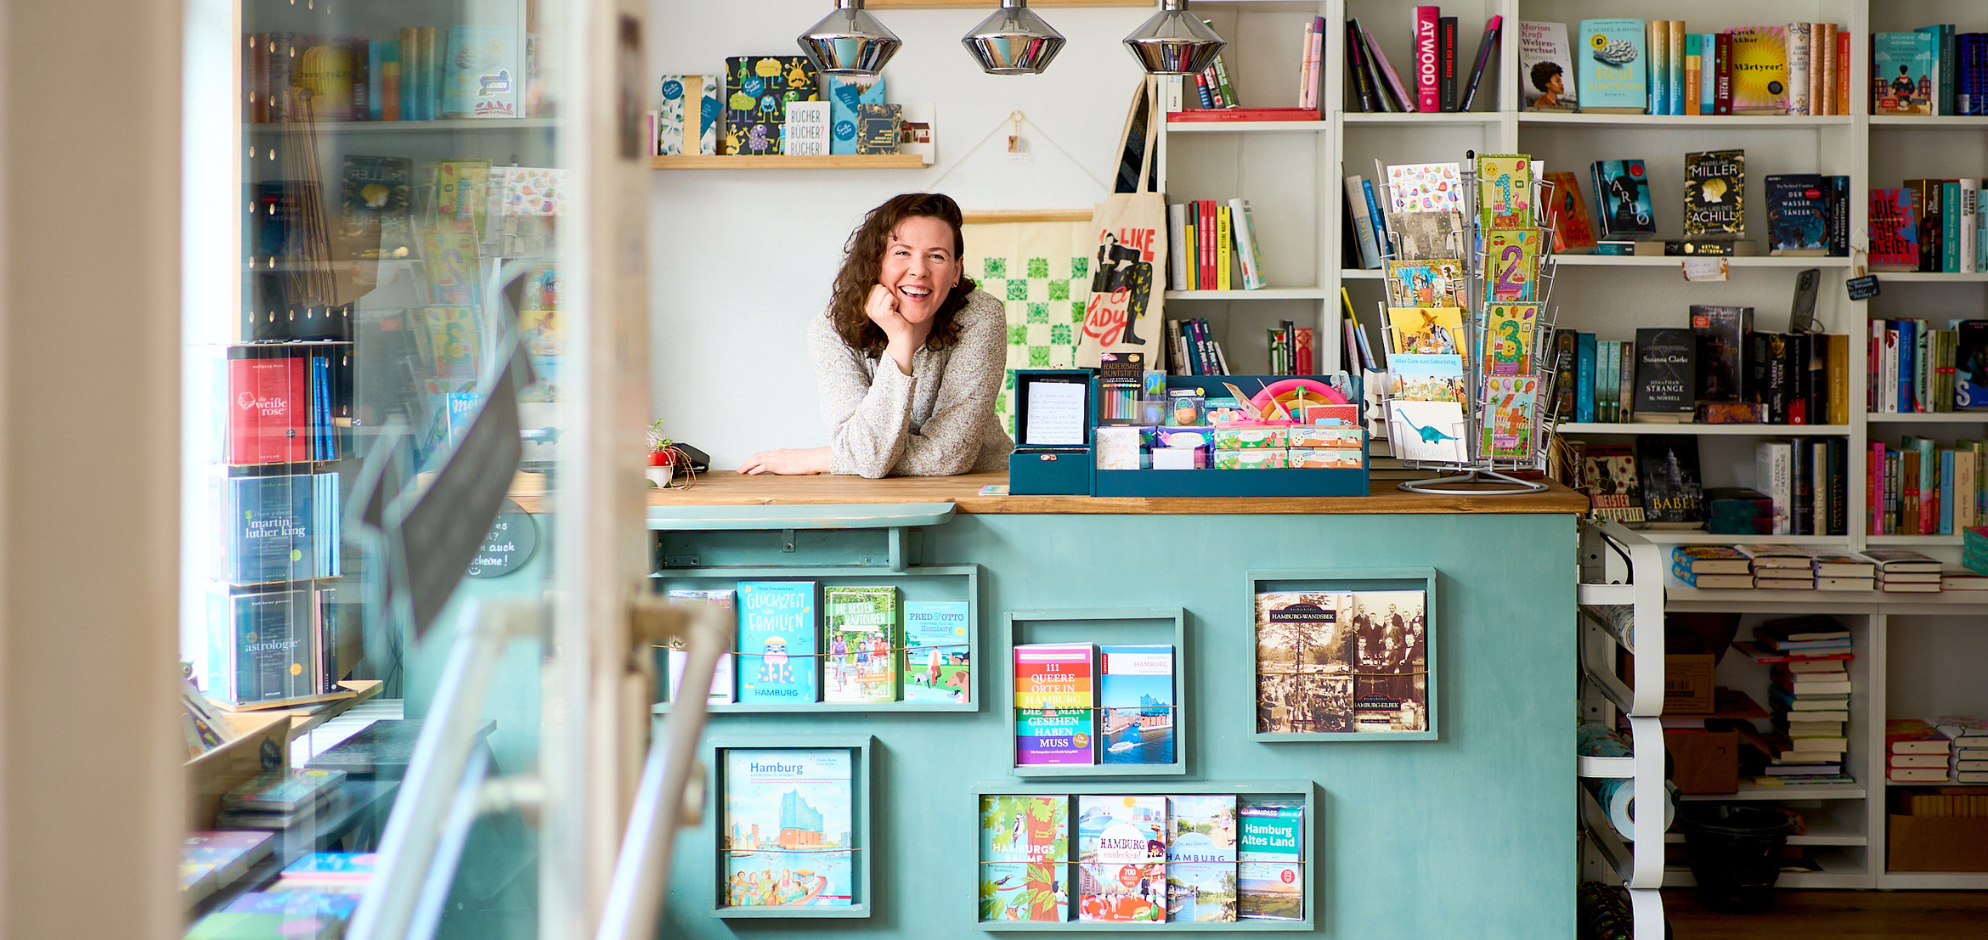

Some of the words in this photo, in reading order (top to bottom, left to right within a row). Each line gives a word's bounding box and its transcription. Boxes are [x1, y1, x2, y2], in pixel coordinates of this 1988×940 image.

[1520, 23, 1550, 32] Marion
[1521, 31, 1542, 39] Kraft
[1420, 20, 1436, 86] ATWOOD
[1523, 46, 1556, 54] wechsel
[1598, 66, 1632, 80] Real
[1734, 64, 1784, 72] Märtyrer!
[1586, 81, 1644, 91] Americans
[790, 108, 822, 123] BÜCHER.
[790, 124, 824, 140] BÜCHER?
[1692, 164, 1737, 178] MILLER
[1495, 174, 1511, 216] 1
[1692, 211, 1736, 223] ACHILL
[1784, 208, 1810, 216] TÄNZER
[1120, 228, 1155, 262] LIKE
[1499, 244, 1524, 290] 2
[1495, 320, 1520, 364] 3
[1104, 362, 1140, 370] RADIERBARE
[1104, 370, 1140, 378] BUNTSTIFTE
[256, 398, 288, 409] weiße
[1495, 393, 1520, 438] 4
[1653, 498, 1698, 510] BABEL
[1833, 474, 1842, 528] KATABASIS
[251, 516, 290, 528] martin
[245, 528, 279, 538] luther
[281, 525, 306, 537] king
[489, 542, 516, 552] auch
[747, 592, 806, 610] GLÜCKSZEIT
[836, 603, 846, 615] DIE
[848, 602, 874, 614] BESTEN
[749, 612, 803, 632] FAMILIEN
[844, 613, 886, 626] RADTOUREN
[910, 612, 932, 620] FRED
[245, 638, 299, 652] astrologie
[1046, 663, 1060, 672] 111
[1031, 674, 1075, 685] QUEERE
[1031, 685, 1060, 693] ORTE
[1062, 685, 1075, 693] IN
[1026, 695, 1082, 704] HAMBURG
[1022, 706, 1042, 716] DIE
[1058, 706, 1085, 716] MAN
[1028, 717, 1079, 726] GESEHEN
[1034, 728, 1073, 737] HABEN
[1040, 738, 1069, 748] MUSS
[750, 762, 804, 775] Hamburg
[1245, 824, 1292, 838] Hamburg
[1100, 838, 1146, 850] HAMBURG
[1242, 836, 1268, 846] Altes
[1270, 836, 1295, 848] Land
[992, 844, 1056, 854] HAMBURGS
[1104, 850, 1142, 860] entdecken!
[1166, 853, 1225, 862] HAMBURG
[1124, 868, 1136, 876] 700
